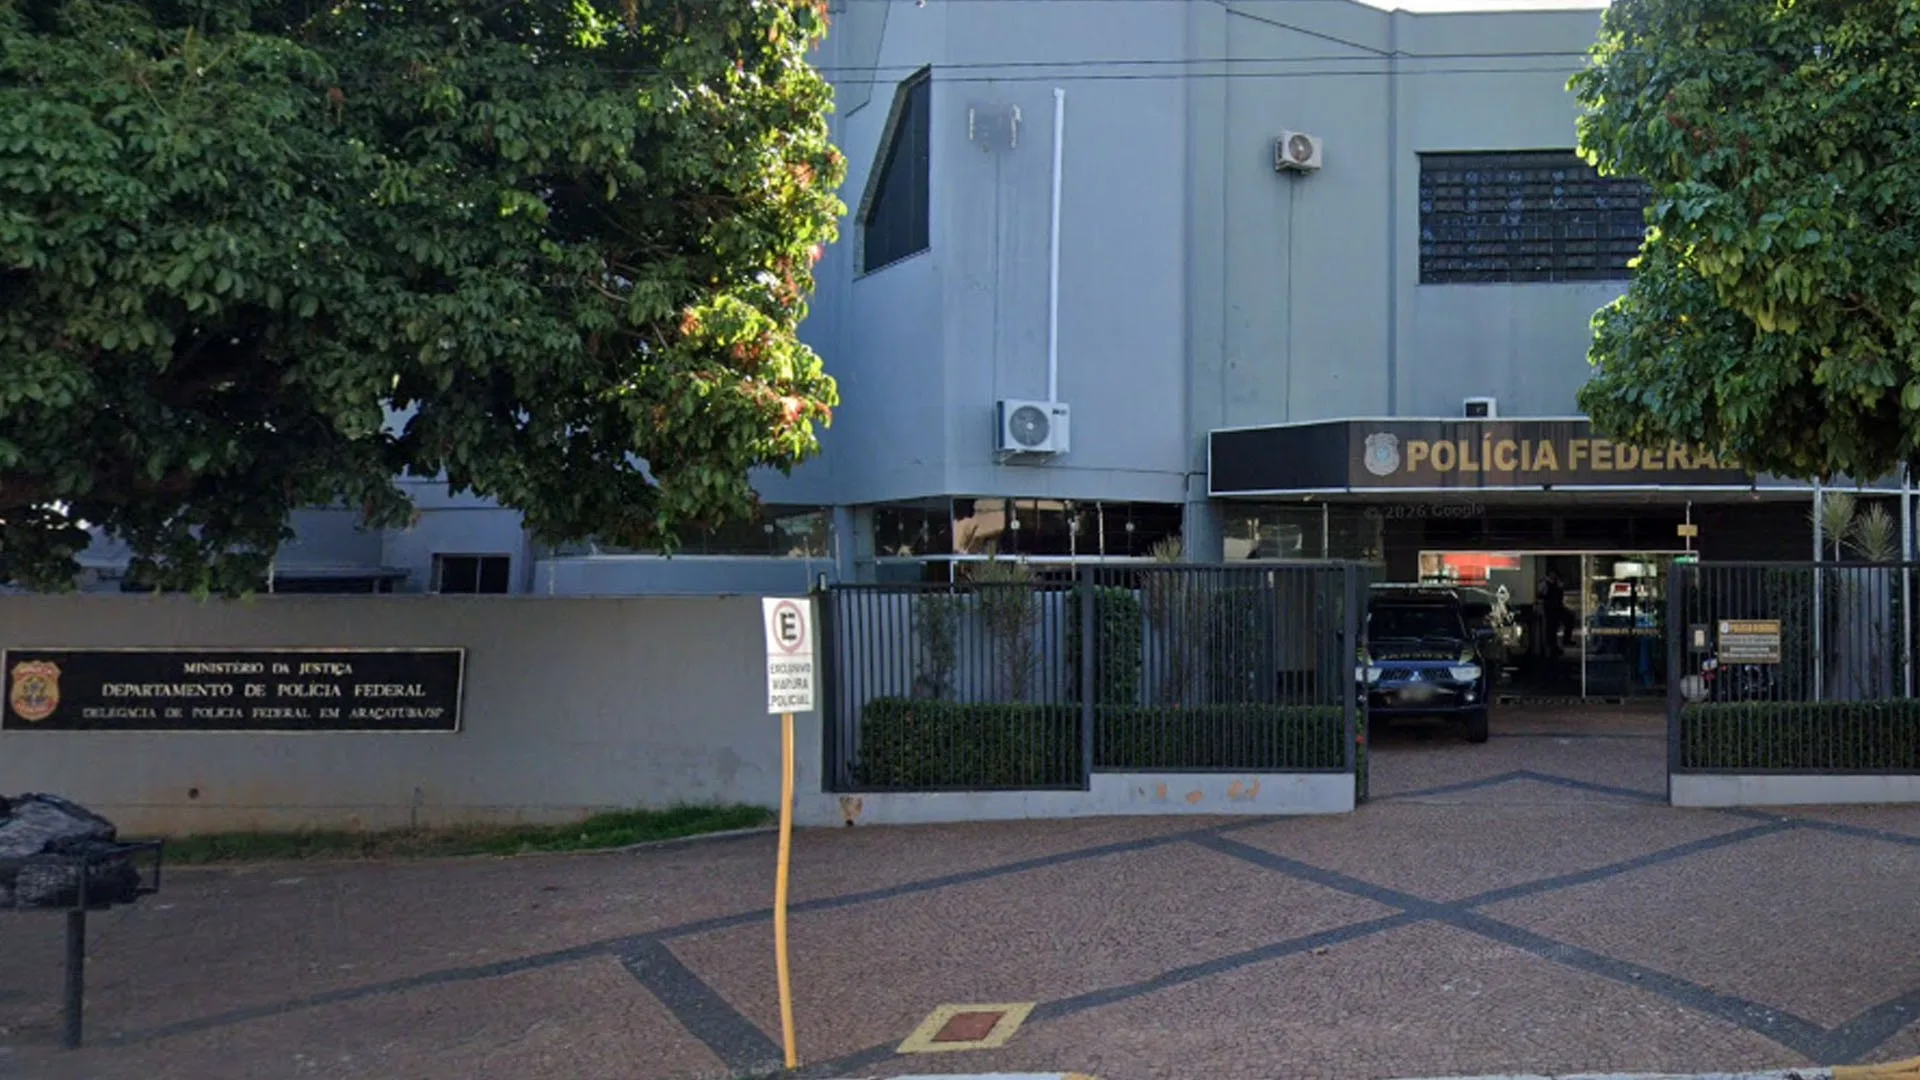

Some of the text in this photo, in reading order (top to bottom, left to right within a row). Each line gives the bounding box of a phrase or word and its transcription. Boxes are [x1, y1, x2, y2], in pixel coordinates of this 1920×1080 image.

[1406, 432, 1560, 473] POLÍCIA
[780, 612, 797, 640] E
[272, 662, 290, 675] DA
[299, 662, 353, 676] JUSTIÇA
[102, 683, 233, 698] DEPARTAMENTO
[244, 683, 267, 698] DE
[354, 683, 426, 698] FEDERAL
[770, 694, 810, 707] POLICIAL
[164, 707, 183, 719] DE
[252, 707, 311, 719] FEDERAL
[319, 707, 340, 719] EM
